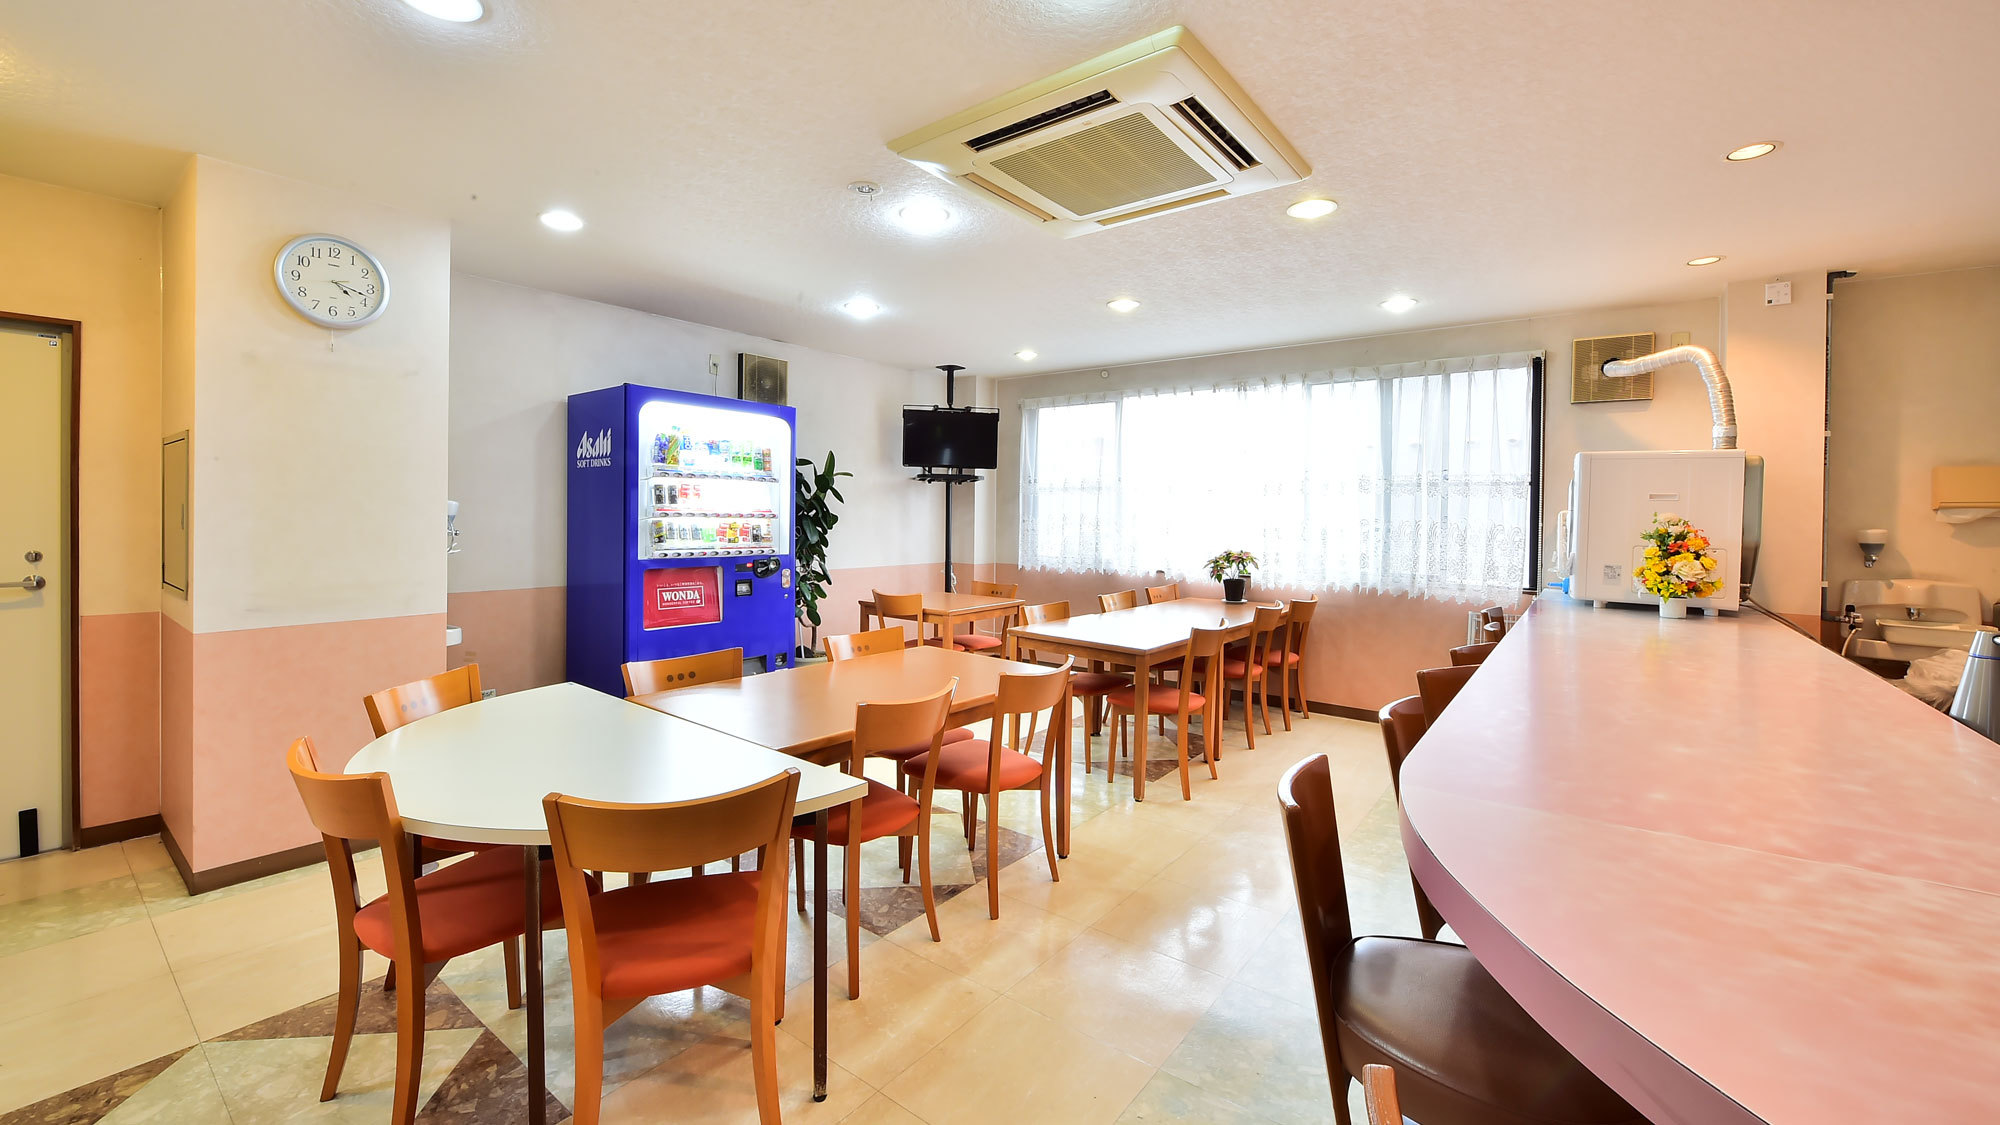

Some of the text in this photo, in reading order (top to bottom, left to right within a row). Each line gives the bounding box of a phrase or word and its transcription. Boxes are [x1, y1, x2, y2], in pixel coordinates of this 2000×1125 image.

[311, 247, 321, 258] 11
[328, 247, 341, 259] 12
[297, 255, 310, 267] 10
[350, 256, 356, 266] 1
[291, 270, 301, 281] 9
[361, 268, 369, 279] 2
[298, 286, 307, 297] 8
[366, 284, 375, 294] 3
[312, 300, 320, 310] 7
[360, 298, 368, 307] 4
[328, 306, 338, 317] 6
[348, 307, 356, 316] 5
[576, 428, 612, 459] Asahi
[576, 457, 612, 468] SOFT DRINKS
[662, 590, 700, 602] WONDA
